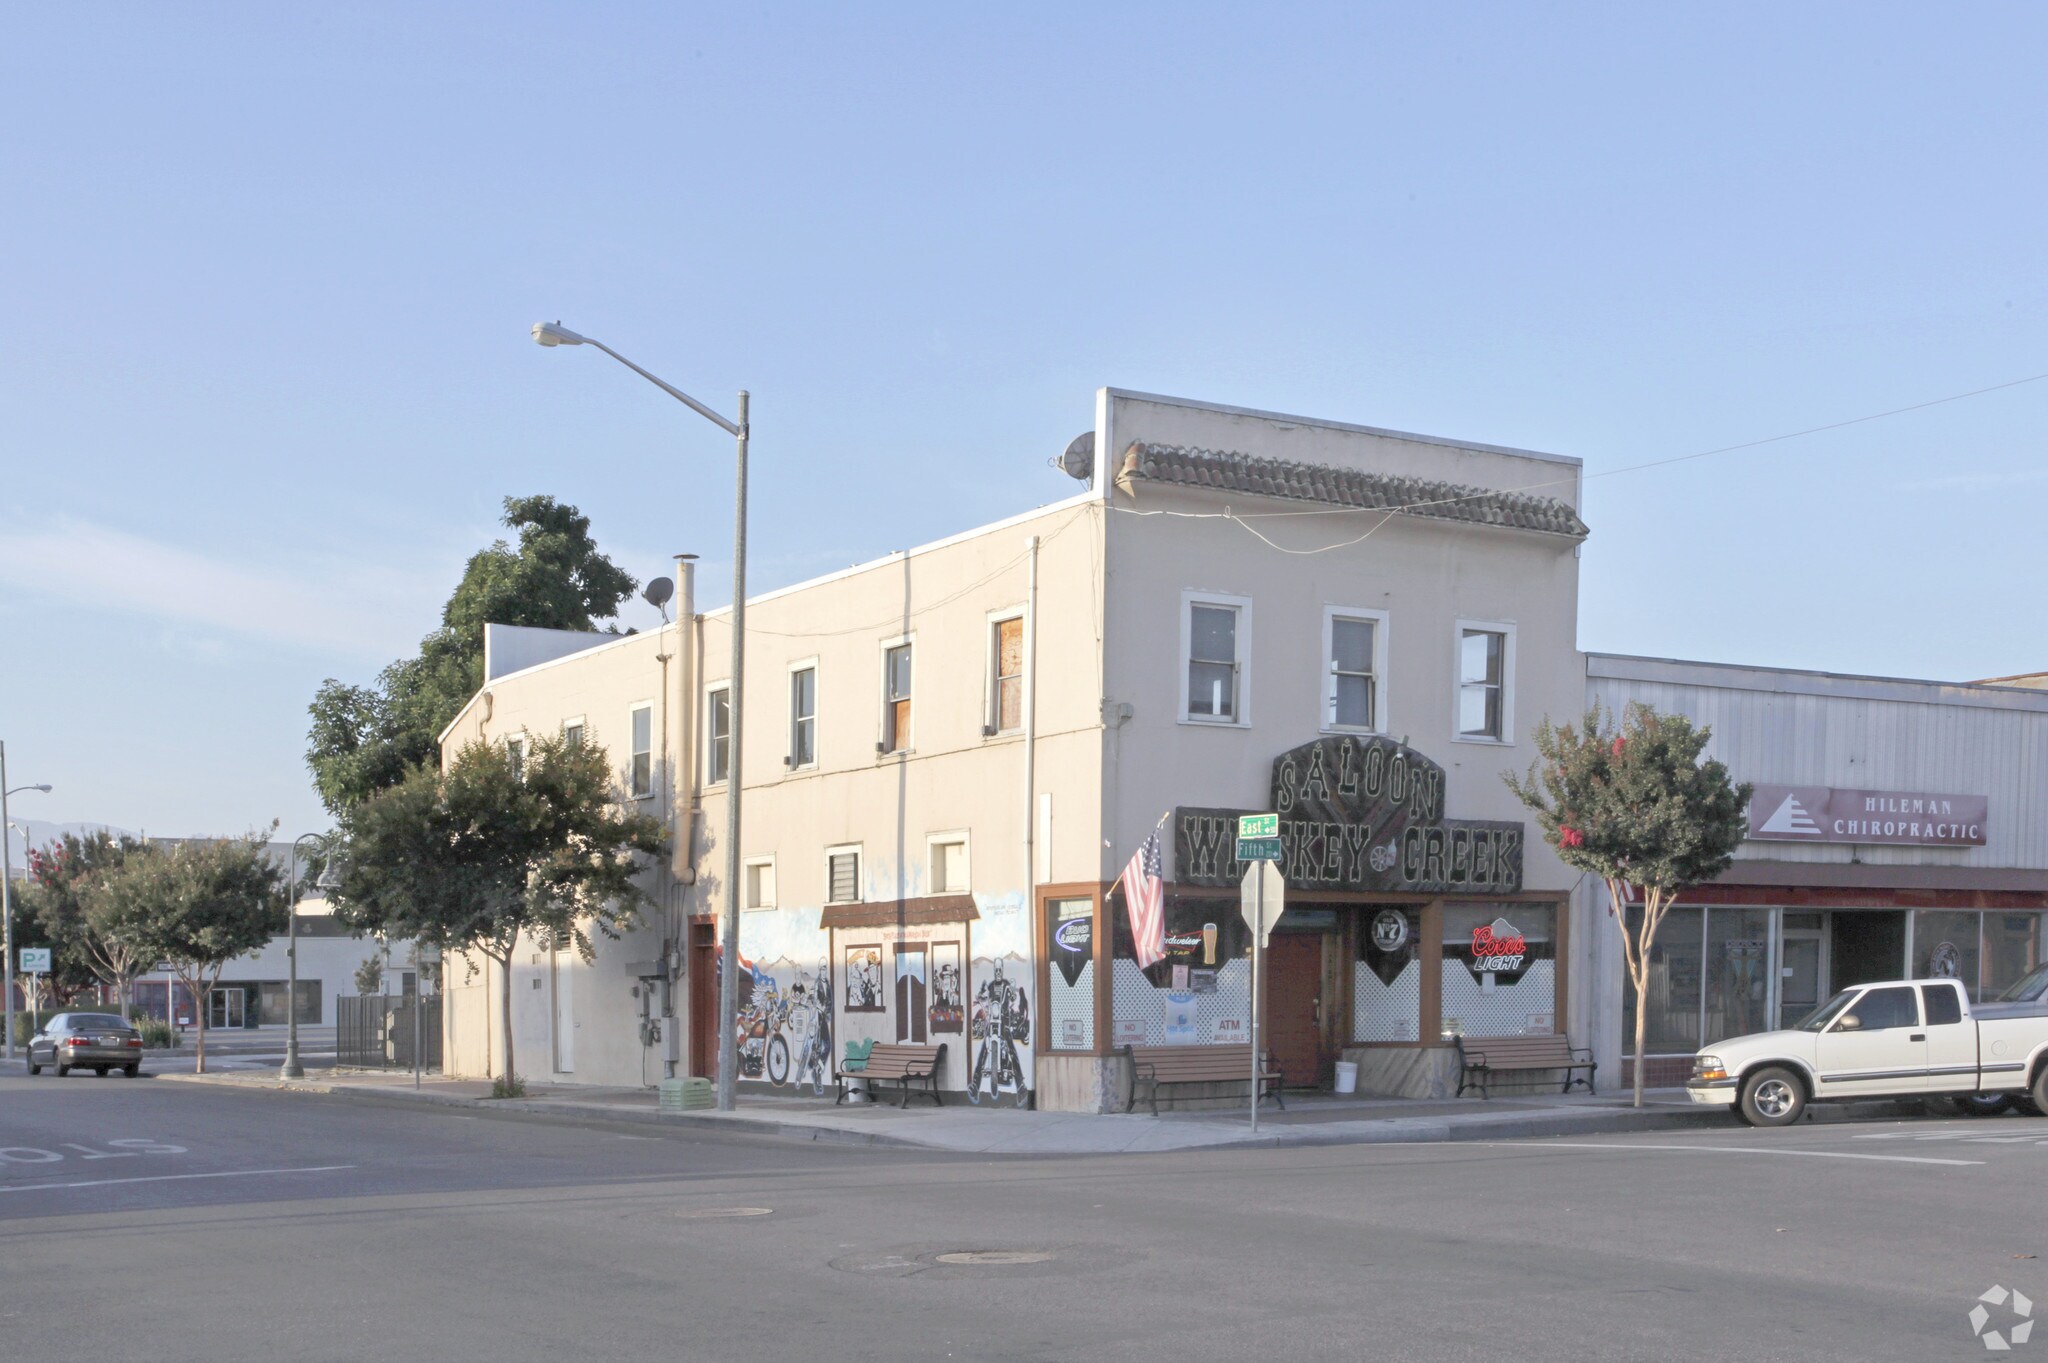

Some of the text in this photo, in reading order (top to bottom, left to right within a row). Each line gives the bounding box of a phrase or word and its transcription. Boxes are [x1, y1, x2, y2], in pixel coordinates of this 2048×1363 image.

[1278, 744, 1438, 819] SALOON
[1865, 797, 1951, 814] HILEMAN
[1241, 820, 1262, 834] East
[1834, 819, 1978, 839] CHIROPRACTIC
[1238, 842, 1264, 856] Fifth
[1403, 826, 1517, 886] CREEK
[1066, 925, 1089, 934] BUD
[1061, 933, 1090, 943] LIGHT
[1164, 935, 1201, 945] udweiser
[1472, 925, 1526, 956] Coors
[1474, 956, 1523, 970] LIGHT
[1069, 1023, 1077, 1032] NO
[1125, 1023, 1136, 1032] NO
[1219, 1020, 1240, 1030] ATM
[0, 1138, 188, 1166] STO
